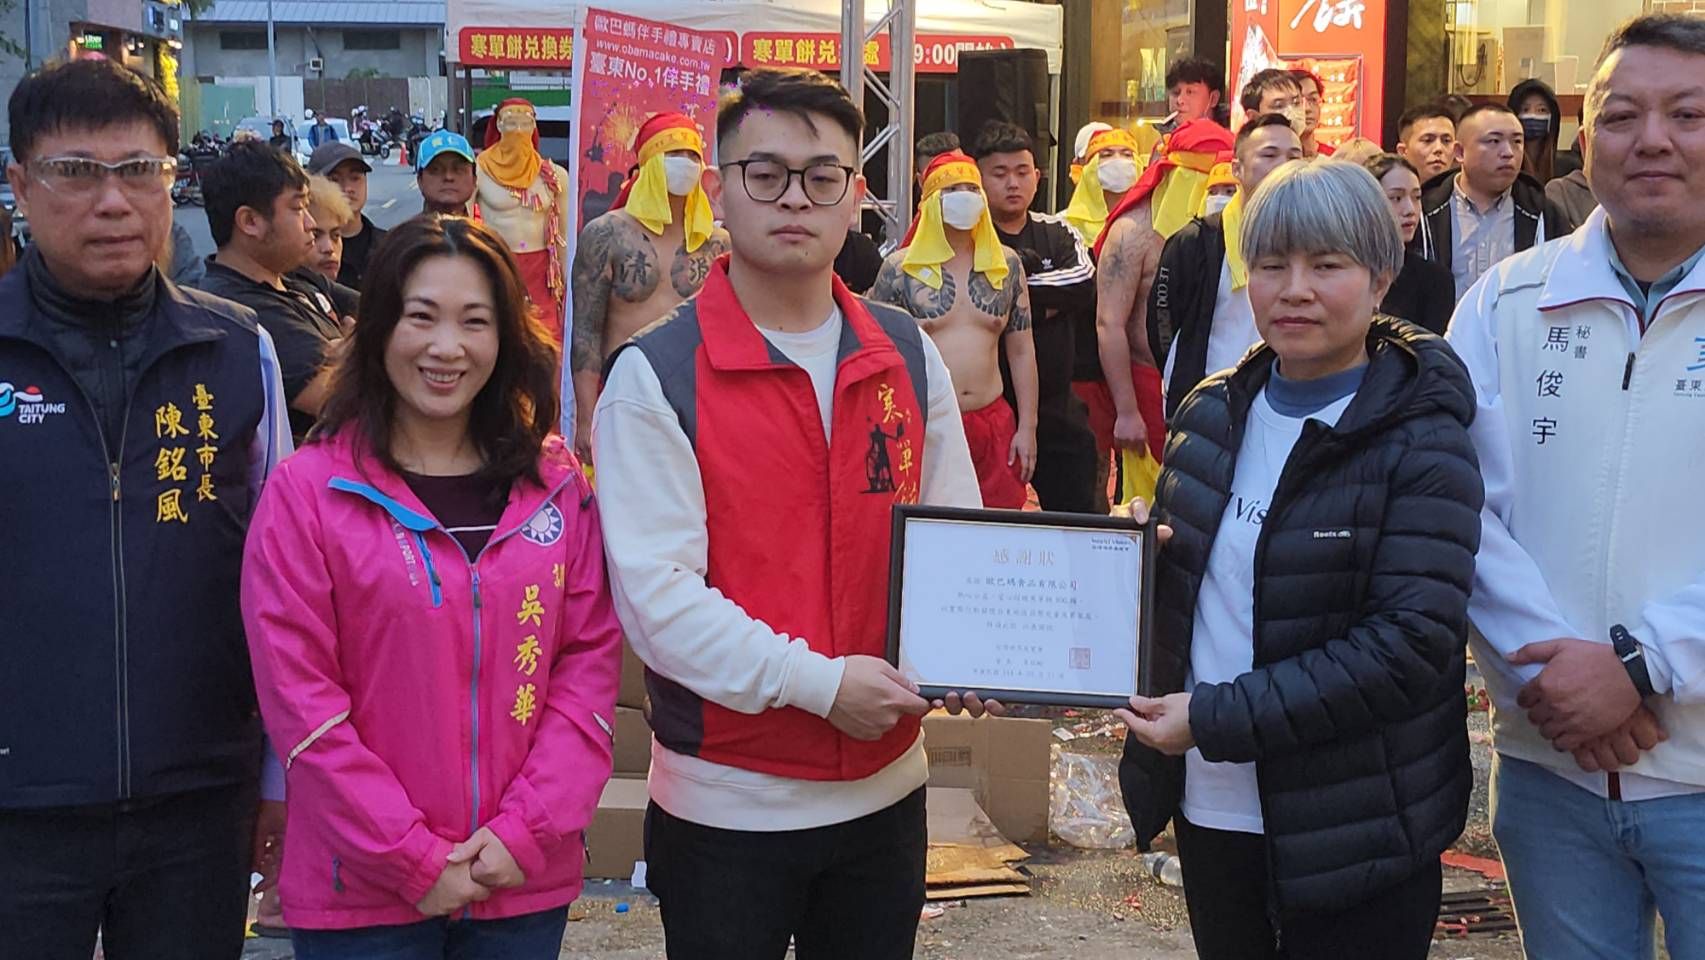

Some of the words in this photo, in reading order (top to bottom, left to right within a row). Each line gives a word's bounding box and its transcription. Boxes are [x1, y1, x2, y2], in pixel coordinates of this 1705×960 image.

[1531, 326, 1570, 445] 馬俊宇
[1573, 325, 1591, 360] 秘書
[19, 403, 66, 414] TAITUNG
[19, 414, 45, 424] CITY
[154, 401, 189, 524] 陳銘風
[193, 383, 219, 502] 臺東市長
[510, 584, 545, 727] 吳秀華
